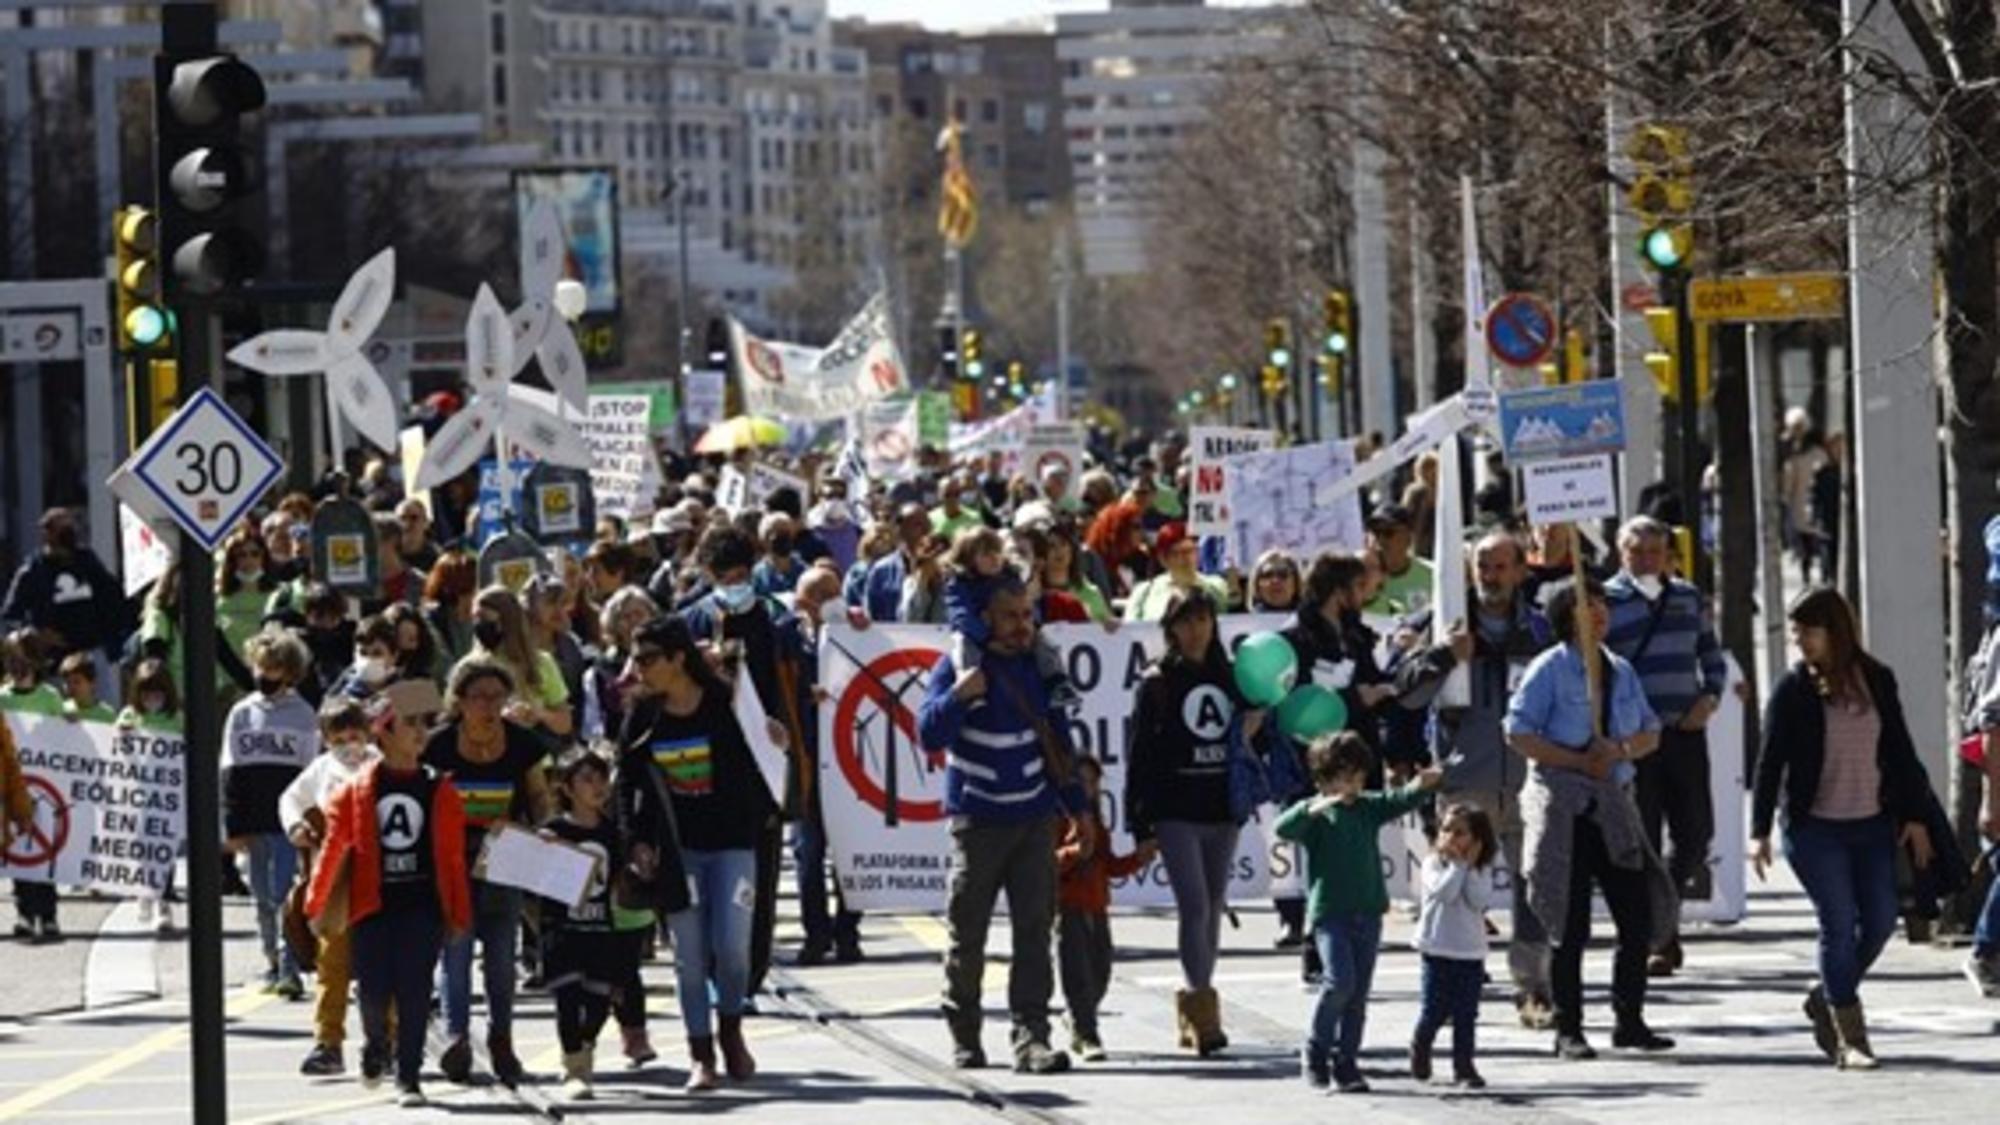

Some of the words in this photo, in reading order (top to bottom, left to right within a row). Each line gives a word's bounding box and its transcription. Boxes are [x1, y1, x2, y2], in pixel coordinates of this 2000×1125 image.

[176, 440, 242, 496] 30
[1196, 694, 1225, 729] A
[18, 747, 181, 786] GACENTRALES
[71, 779, 179, 812] EÓLICAS
[103, 810, 137, 832] EN
[144, 817, 176, 838] EL
[384, 803, 413, 838] A
[90, 835, 173, 863] MEDIO
